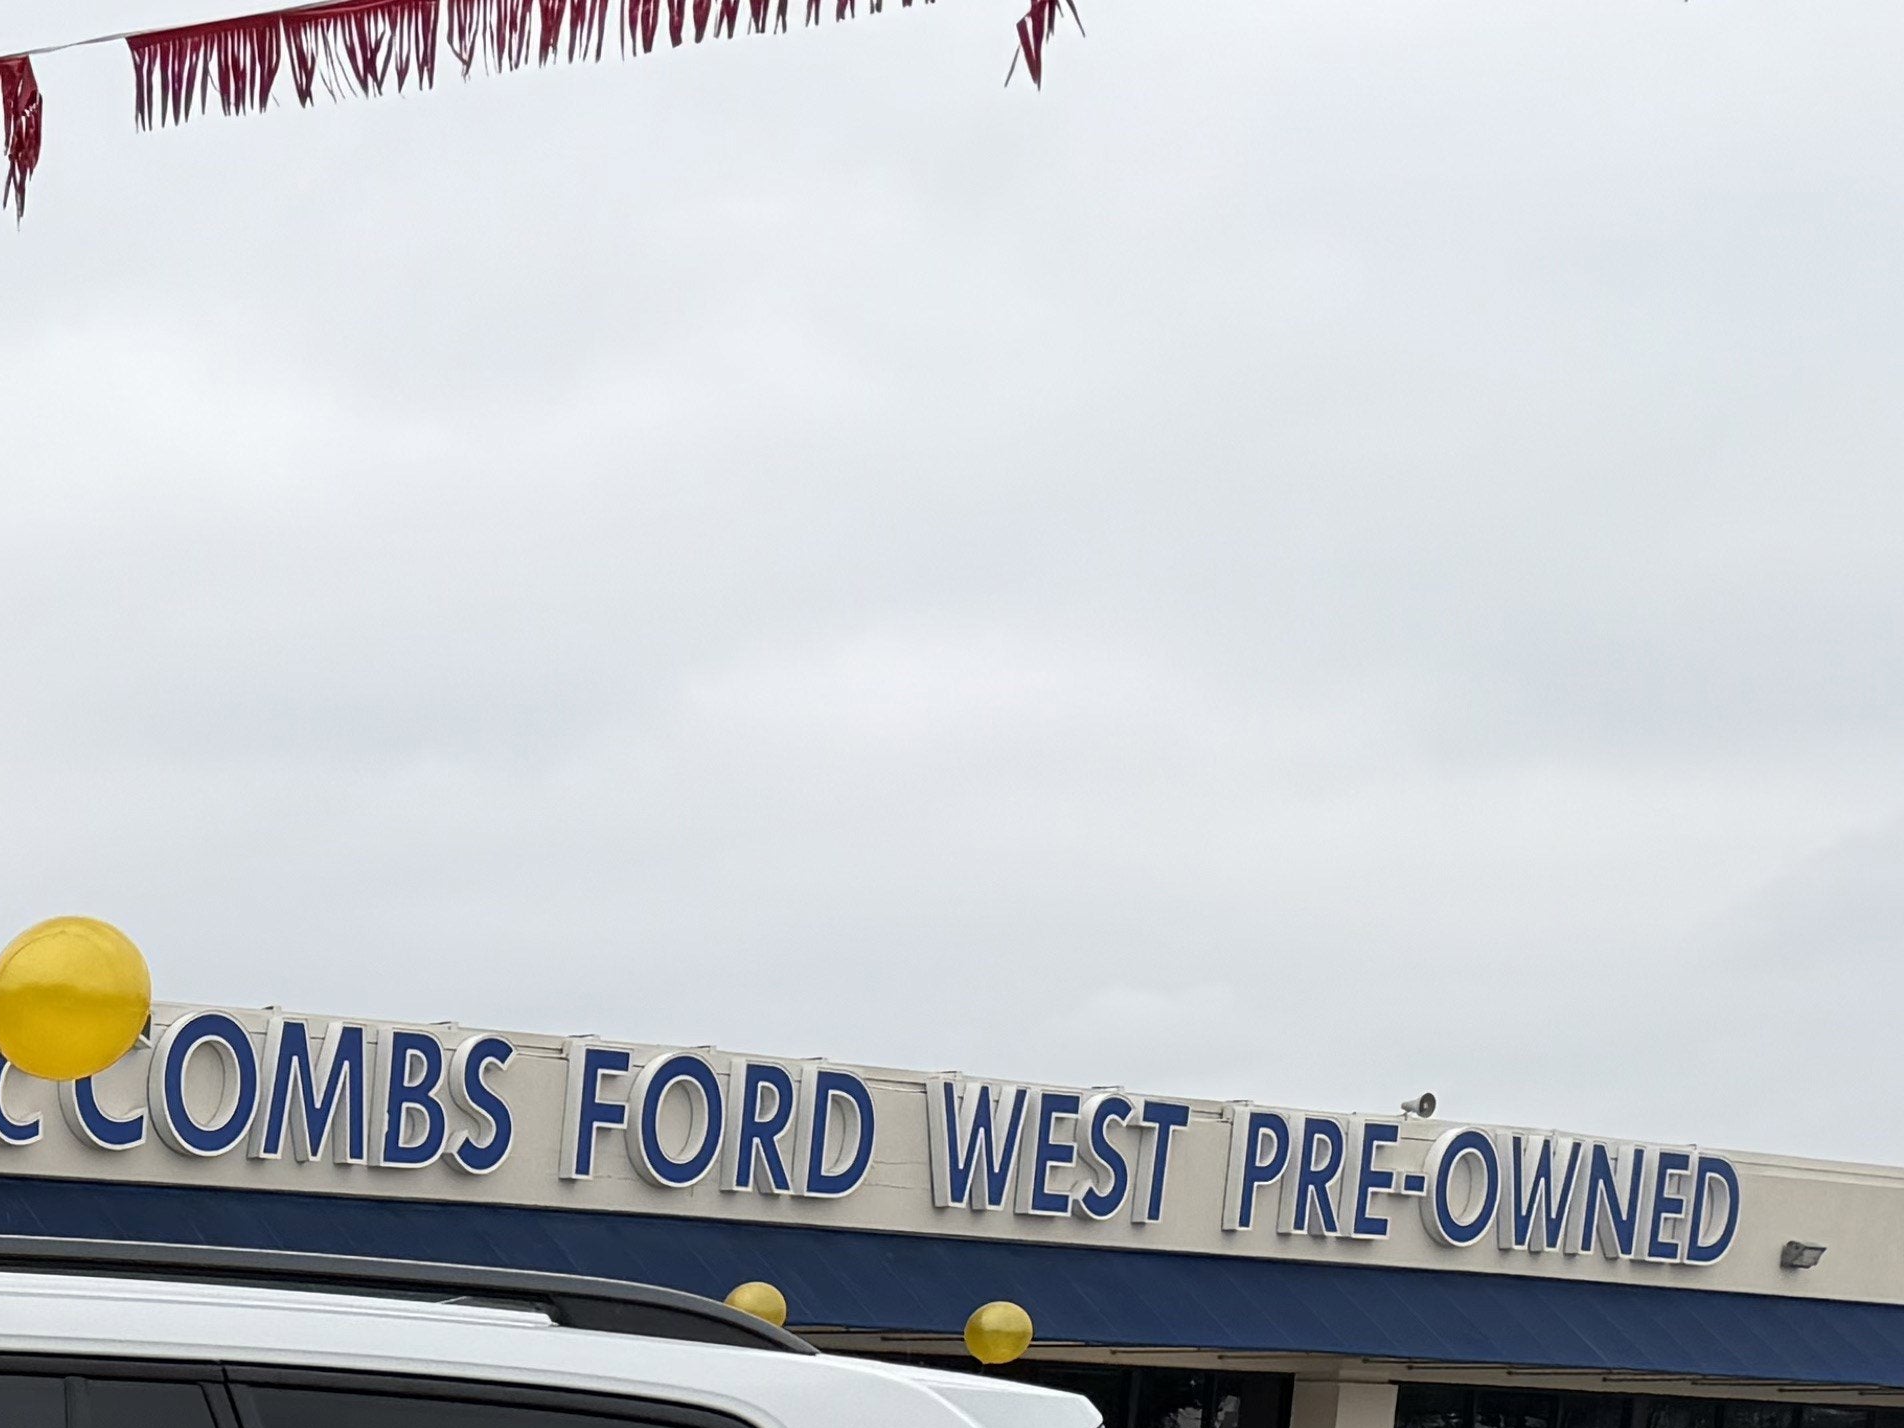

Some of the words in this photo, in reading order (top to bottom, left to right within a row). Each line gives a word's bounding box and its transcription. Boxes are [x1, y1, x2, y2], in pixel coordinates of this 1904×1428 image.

[561, 1044, 876, 1199] FORD
[930, 1077, 1190, 1223] WEST
[1226, 1106, 1741, 1267] PRE-OWNED
